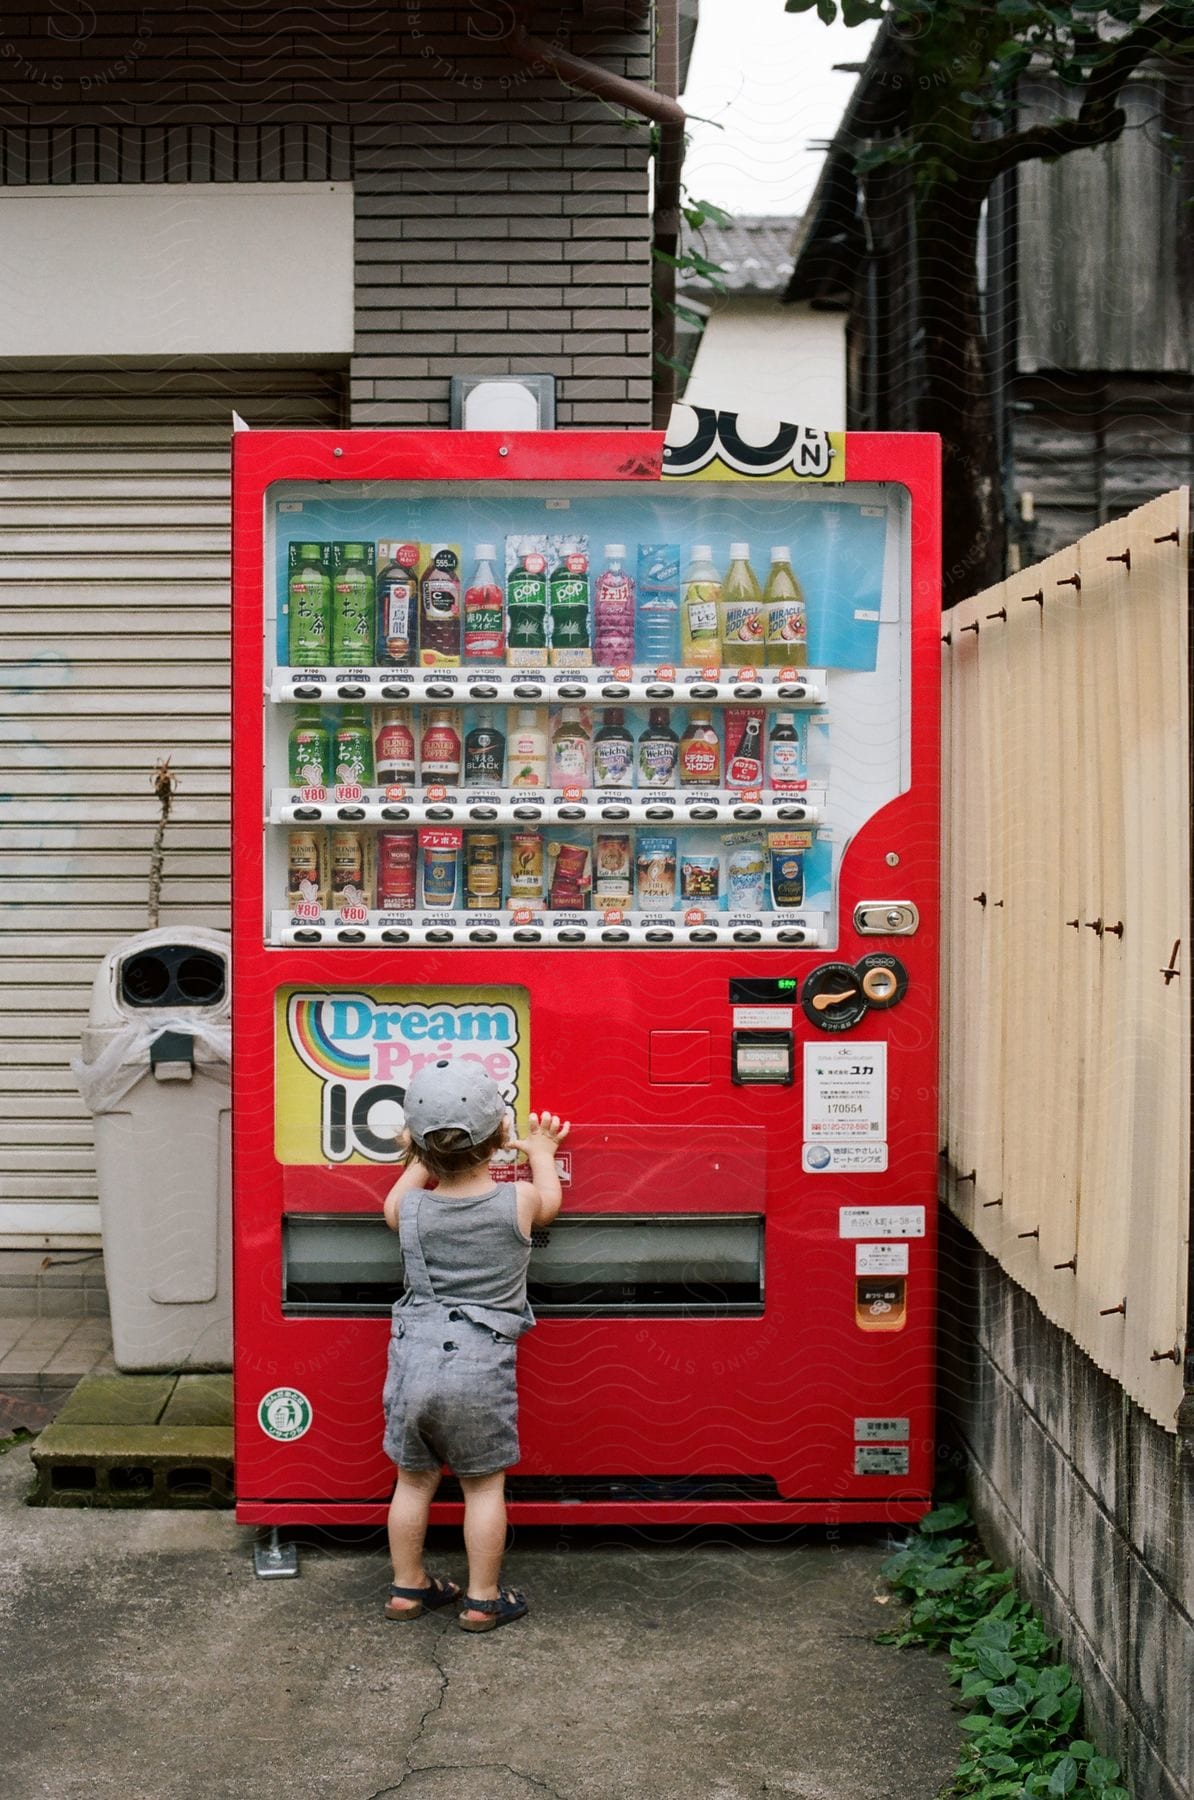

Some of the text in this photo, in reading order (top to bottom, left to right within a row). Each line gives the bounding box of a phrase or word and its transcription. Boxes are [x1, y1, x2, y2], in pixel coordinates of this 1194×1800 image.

[513, 582, 540, 602] pop
[557, 582, 582, 602] pop
[304, 789, 325, 800] ¥80
[338, 788, 359, 798] ¥80
[297, 905, 318, 917] ¥80
[343, 909, 365, 919] ¥80
[330, 1001, 510, 1040] Dream
[850, 1066, 874, 1075] ユカ
[827, 1104, 862, 1113] 170554
